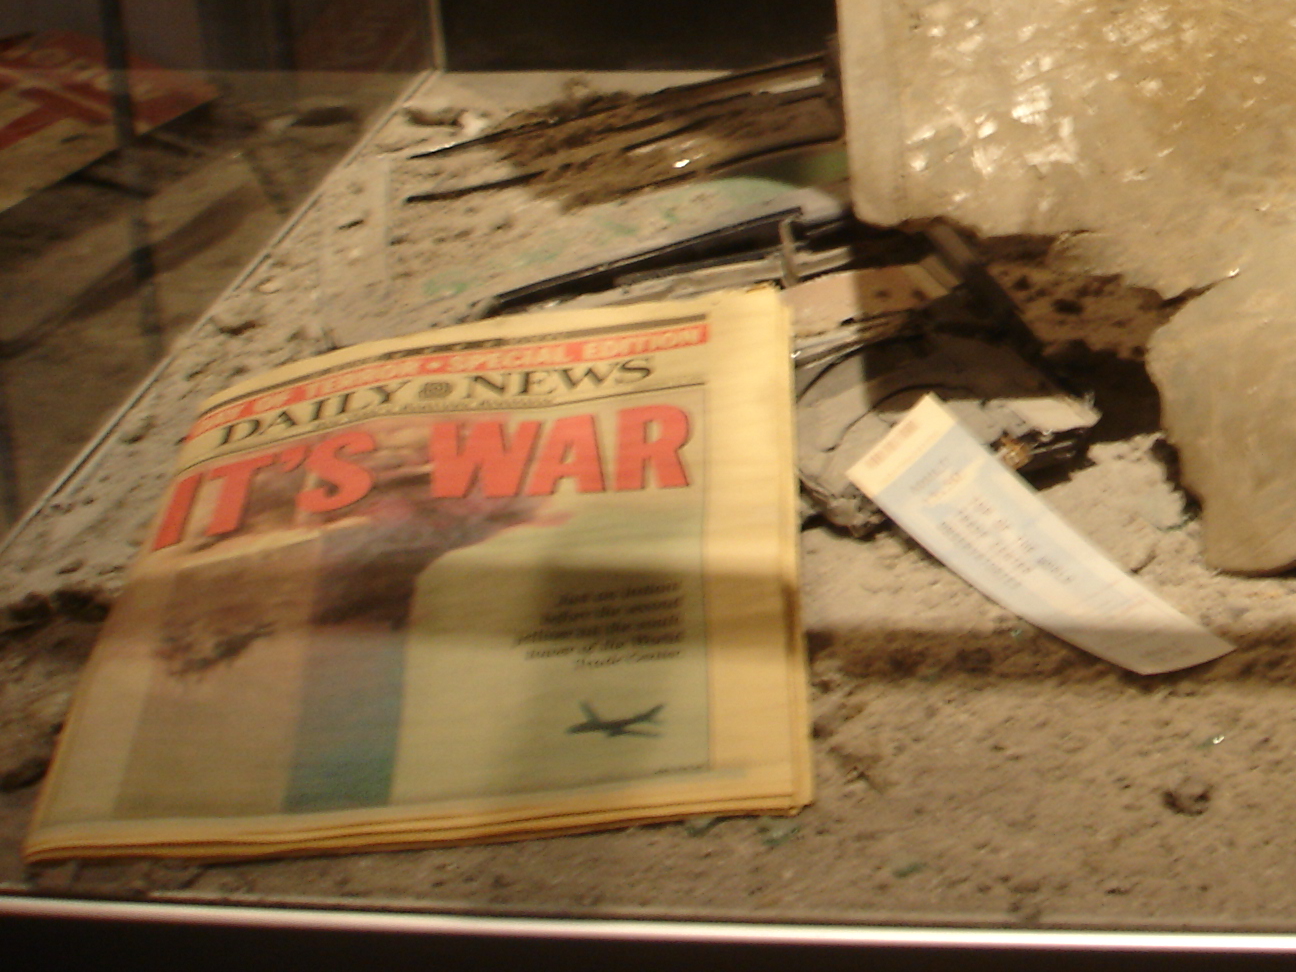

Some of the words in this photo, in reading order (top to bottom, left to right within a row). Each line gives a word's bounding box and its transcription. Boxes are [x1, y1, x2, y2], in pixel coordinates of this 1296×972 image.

[217, 380, 411, 447] DAILY
[463, 357, 657, 399] NEWS
[305, 358, 420, 401] TERROR
[450, 343, 565, 373] SPECIAL
[584, 328, 700, 361] EDITION
[150, 432, 378, 551] IT'S
[428, 404, 691, 499] WAR
